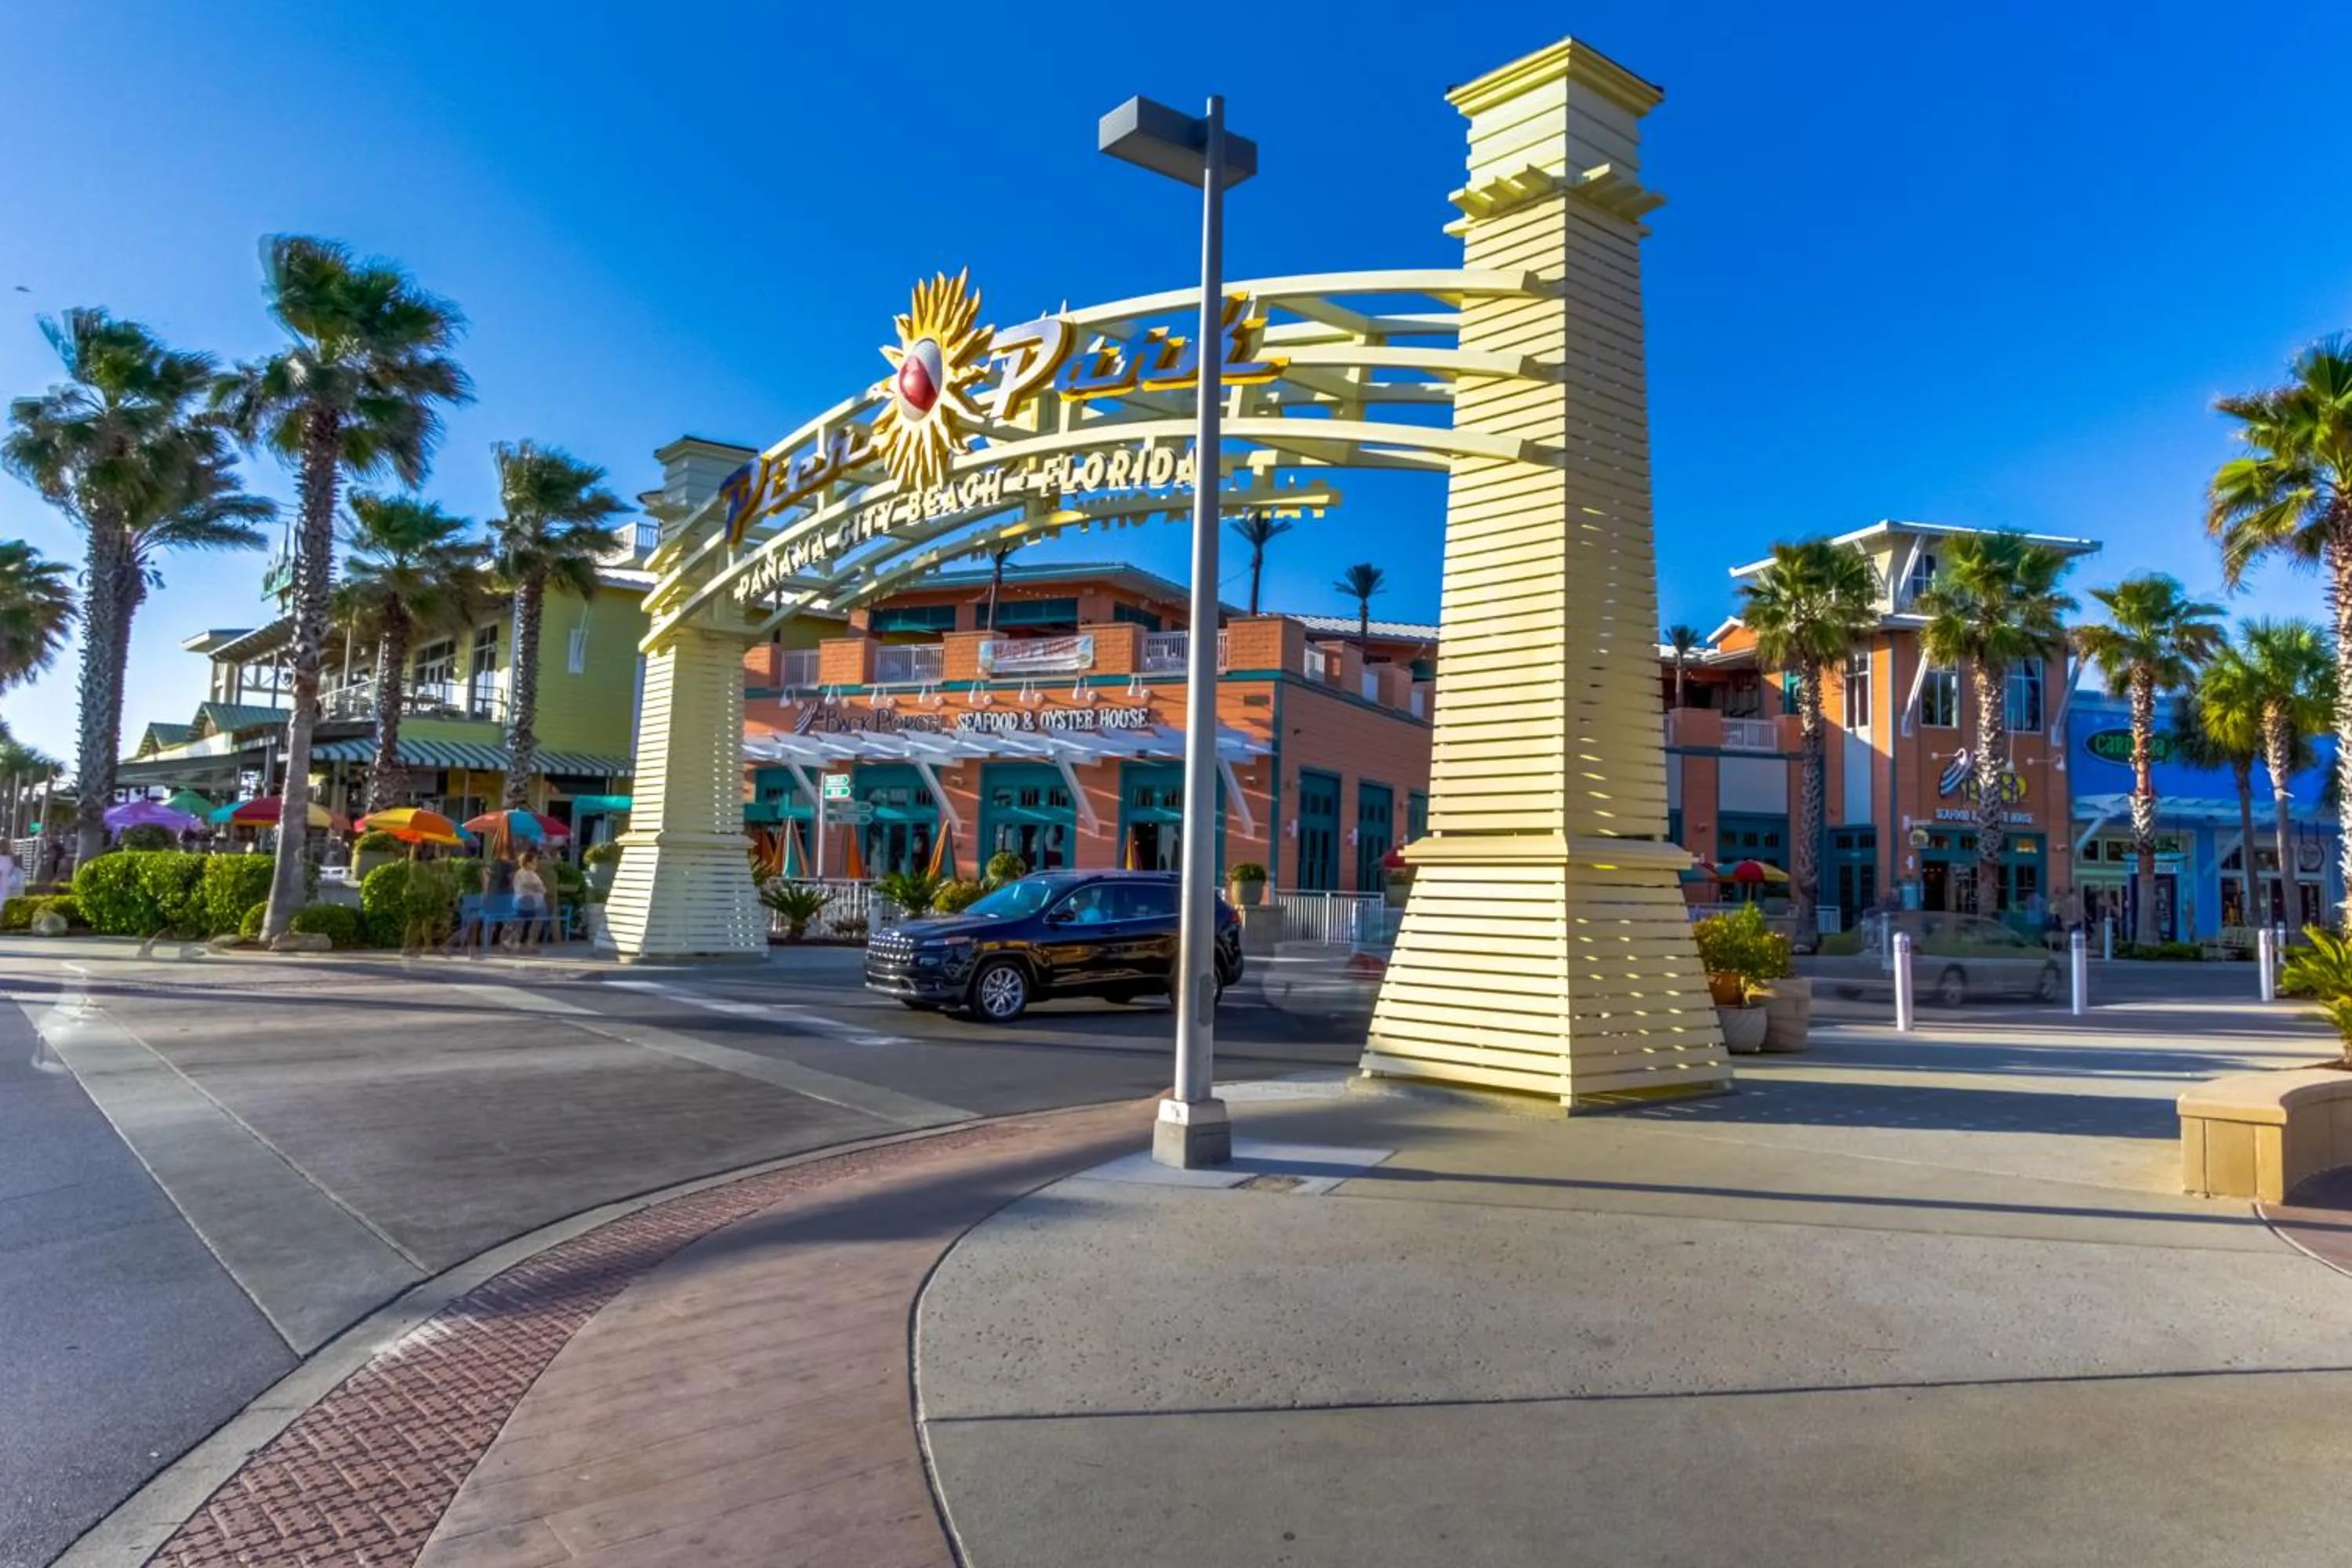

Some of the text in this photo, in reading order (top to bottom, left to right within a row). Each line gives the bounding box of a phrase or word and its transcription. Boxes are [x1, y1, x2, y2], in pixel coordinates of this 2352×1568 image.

[989, 291, 1291, 421] Park
[734, 446, 1197, 604] PANAMA CITY BEACH FLORIDA
[957, 711, 1018, 731] SEAFOOD
[1022, 710, 1035, 731] &
[1040, 708, 1095, 731] OYSTER
[1099, 707, 1149, 729] HOUSE
